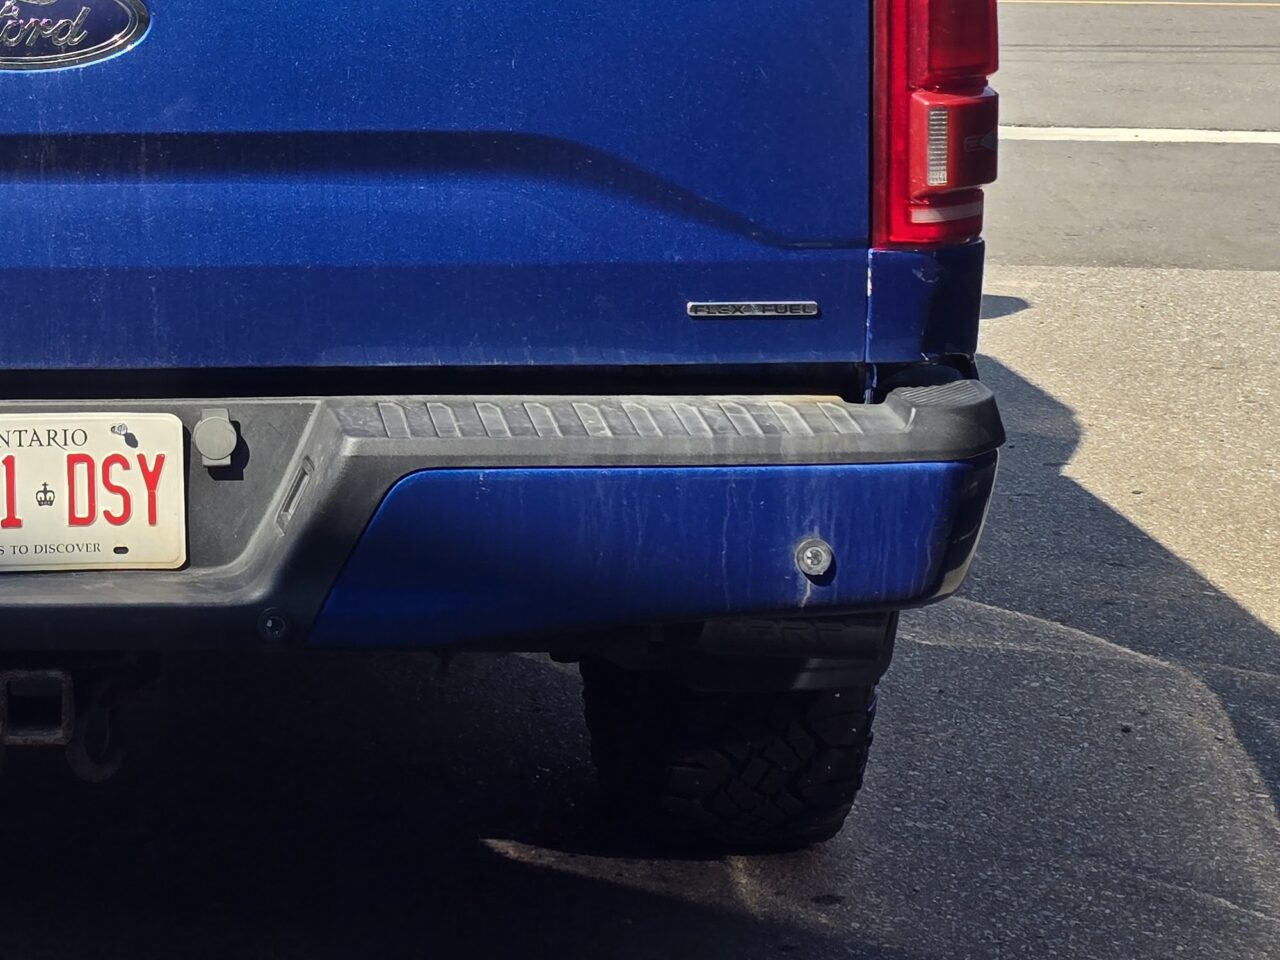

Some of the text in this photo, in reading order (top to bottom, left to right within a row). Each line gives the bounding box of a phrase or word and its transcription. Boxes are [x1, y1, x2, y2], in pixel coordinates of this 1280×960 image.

[693, 303, 814, 315] FLEX FUEL
[66, 452, 166, 527] DSY
[10, 544, 29, 555] TO
[34, 542, 102, 555] DISCOVER
